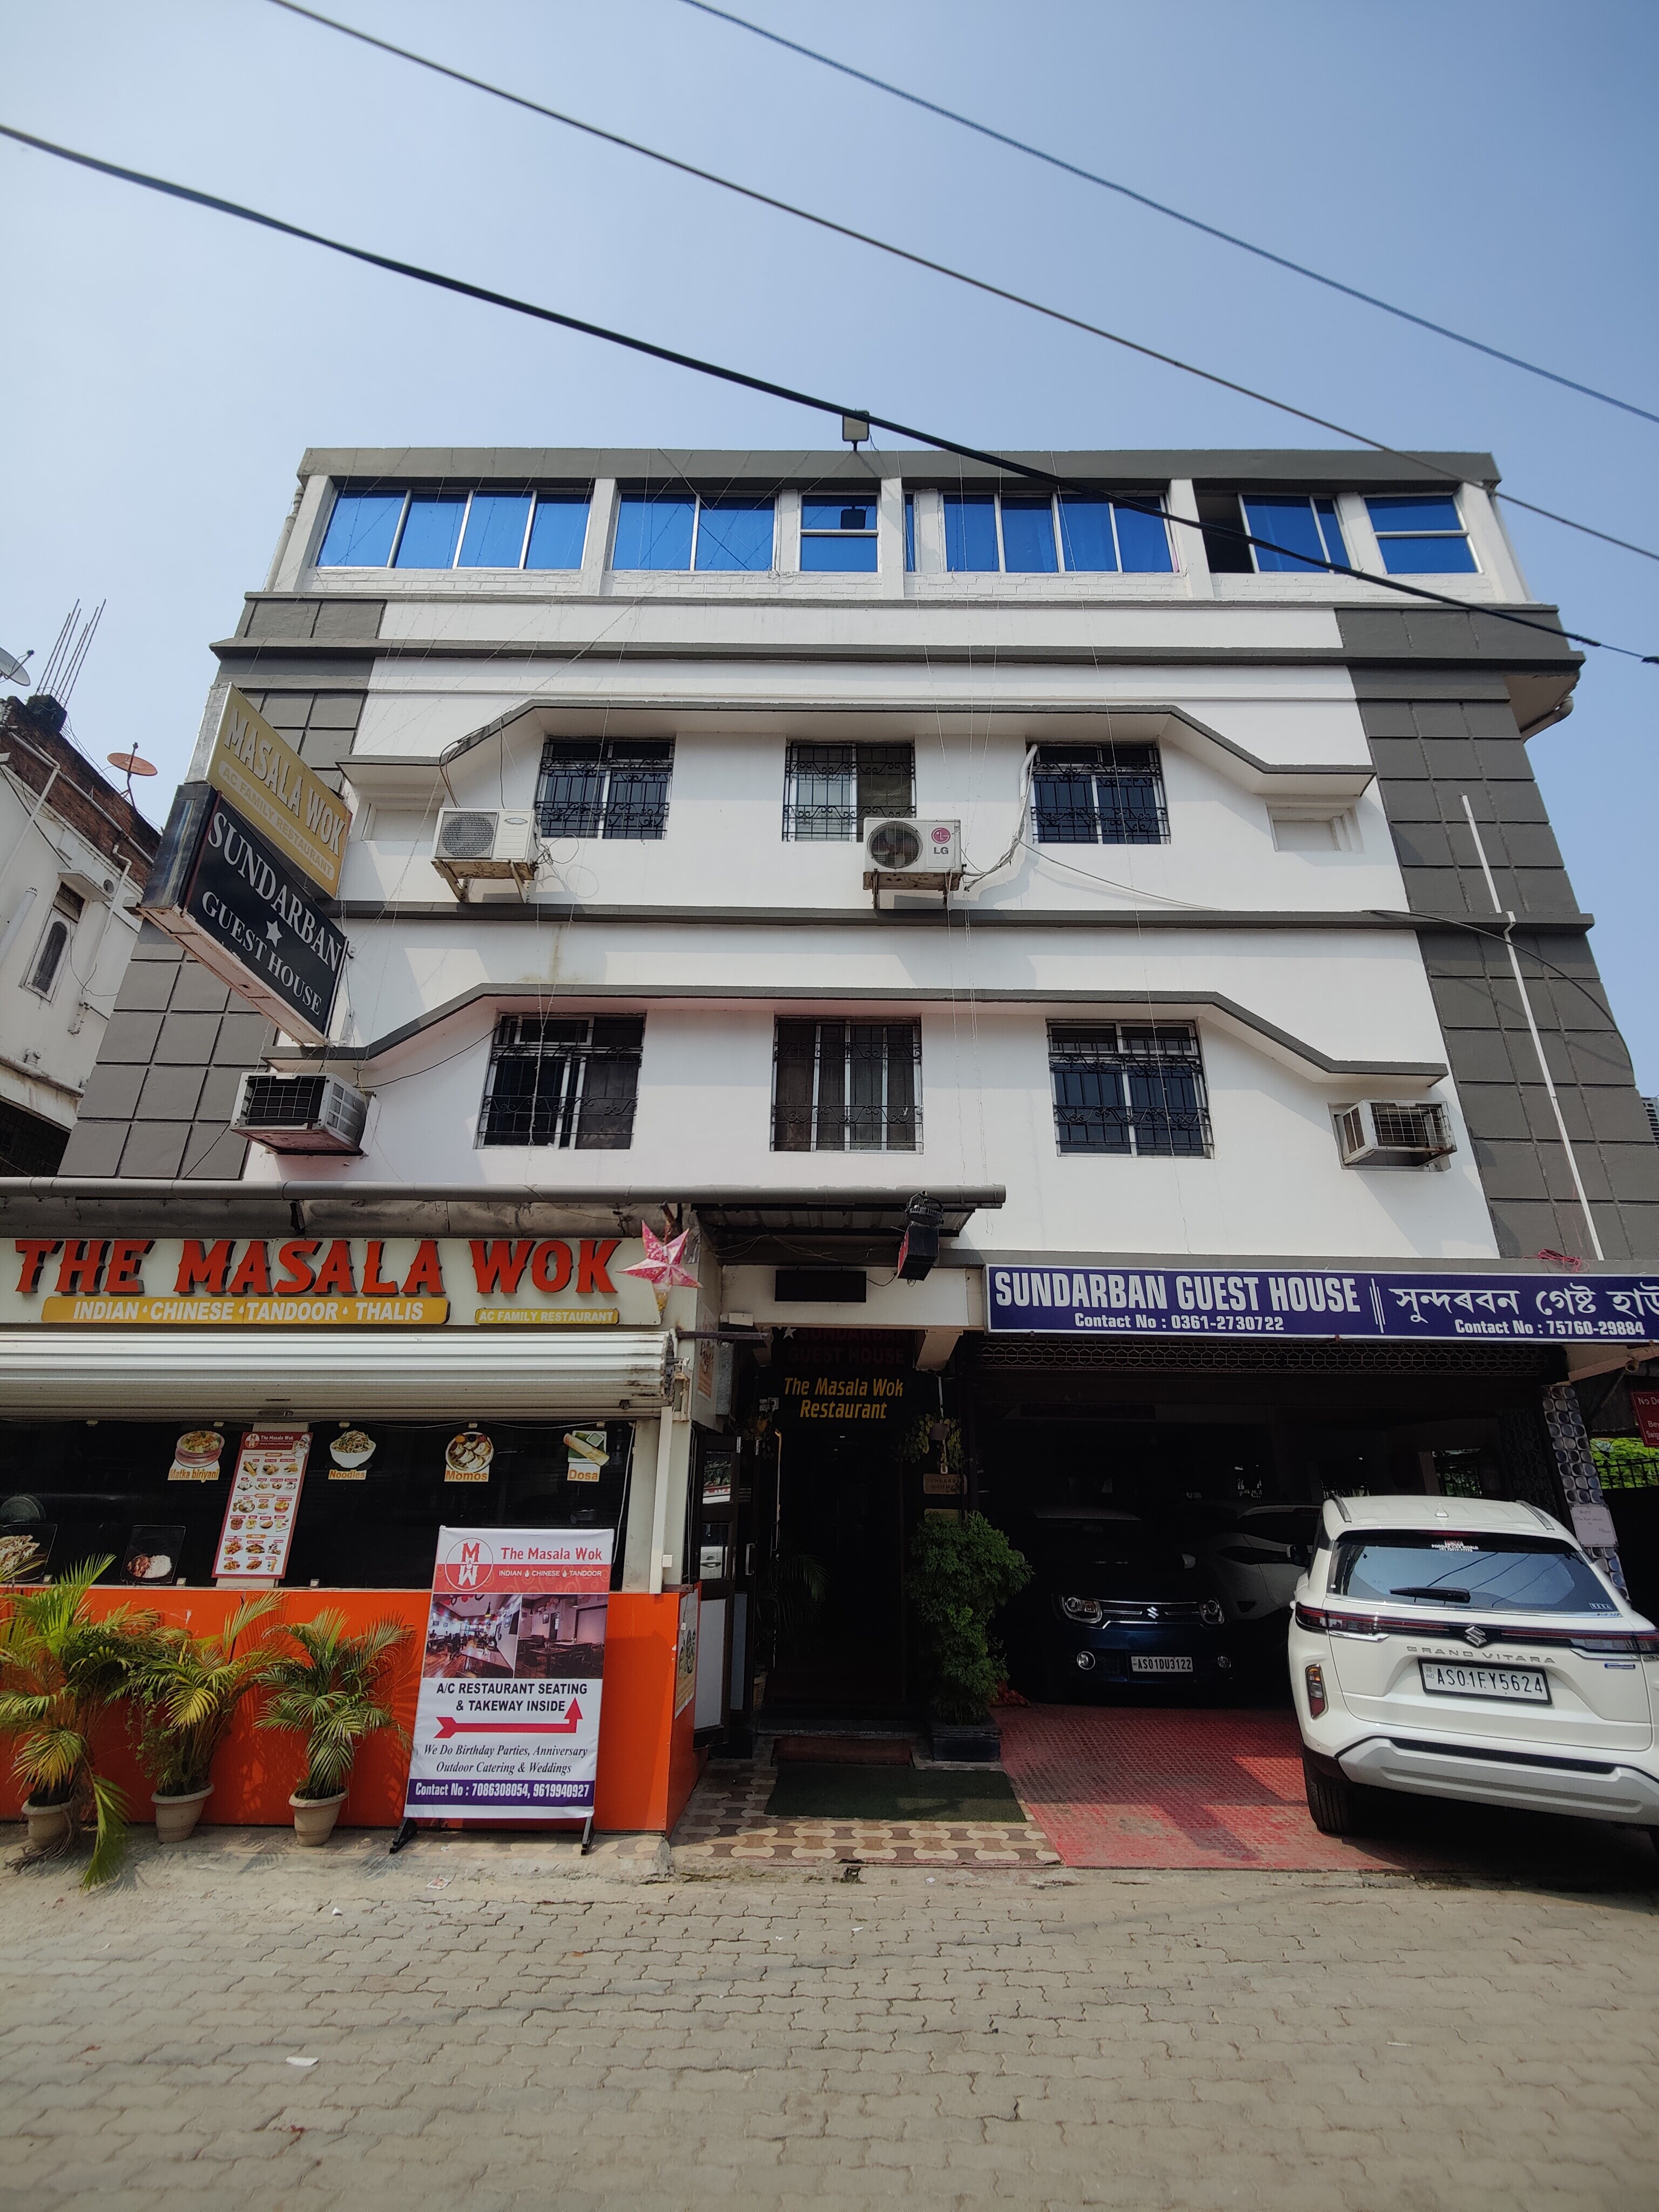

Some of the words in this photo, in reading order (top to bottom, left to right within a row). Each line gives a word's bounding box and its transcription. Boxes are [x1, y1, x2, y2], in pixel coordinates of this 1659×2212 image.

[224, 709, 301, 817] MASALA
[305, 786, 345, 858] WOK
[222, 770, 238, 789] AC
[240, 781, 275, 820] FAMILY
[276, 819, 333, 876] RESTAURANT
[934, 847, 949, 855] LG
[208, 812, 343, 972] SUNDARBAN
[202, 891, 267, 961] GUEST
[267, 954, 322, 1017] HOUSE
[15, 1240, 155, 1295] THE
[173, 1240, 446, 1295] MASALA
[469, 1240, 622, 1294] WOK
[995, 1271, 1168, 1309] SUNDARBAN
[1175, 1275, 1259, 1311] GUEST
[1268, 1277, 1361, 1313] HOUSE
[73, 1301, 138, 1319] INDIAN
[151, 1302, 233, 1320] CHINESE
[247, 1303, 338, 1321] TANDOOR
[355, 1303, 423, 1321] THALIS
[479, 1312, 495, 1321] AC
[497, 1312, 538, 1321] FAMILY
[540, 1312, 613, 1322] RESTAURANT
[1075, 1312, 1131, 1328] Contact
[1136, 1314, 1156, 1328] No
[1171, 1314, 1284, 1331] 0361-2730722
[1455, 1319, 1509, 1334] Contact
[1512, 1320, 1534, 1334] No
[1547, 1320, 1645, 1336] 75760-29884
[787, 1346, 844, 1364] GUEST
[848, 1347, 906, 1365] HOUSE
[784, 1378, 810, 1395] The
[814, 1378, 867, 1397] Masala
[873, 1378, 903, 1397] Wok
[800, 1399, 887, 1419] Restaurant
[169, 1468, 190, 1479] Matka
[191, 1468, 219, 1483] biriyani
[329, 1469, 366, 1479] Noodles
[445, 1471, 488, 1481] Momos
[569, 1469, 598, 1480] Dosa
[500, 1547, 523, 1560] The
[528, 1547, 570, 1560] Masala
[575, 1547, 603, 1561] Wok
[1407, 1645, 1474, 1657] GRAND
[1482, 1651, 1556, 1664] VITARA
[1138, 1658, 1191, 1670] AS01DU3122
[436, 1683, 455, 1694] A/C
[458, 1683, 535, 1694] RESTAURANT
[538, 1683, 588, 1695] SEATING
[456, 1700, 464, 1711] &
[468, 1700, 523, 1711] TAKEWAY
[527, 1700, 565, 1712] INSIDE
[424, 1744, 437, 1755] We
[440, 1744, 453, 1755] Do
[455, 1744, 495, 1757] Birthday
[497, 1744, 530, 1757] Parties,
[532, 1745, 588, 1758] Anniversary
[436, 1761, 474, 1773] Outdoor
[476, 1762, 515, 1776] Catering
[517, 1762, 525, 1773] &
[528, 1762, 572, 1776] Weddings
[415, 1783, 448, 1796] Contact
[451, 1783, 463, 1796] No
[471, 1783, 530, 1799] 7086308054,
[533, 1783, 589, 1798] 9619940927
